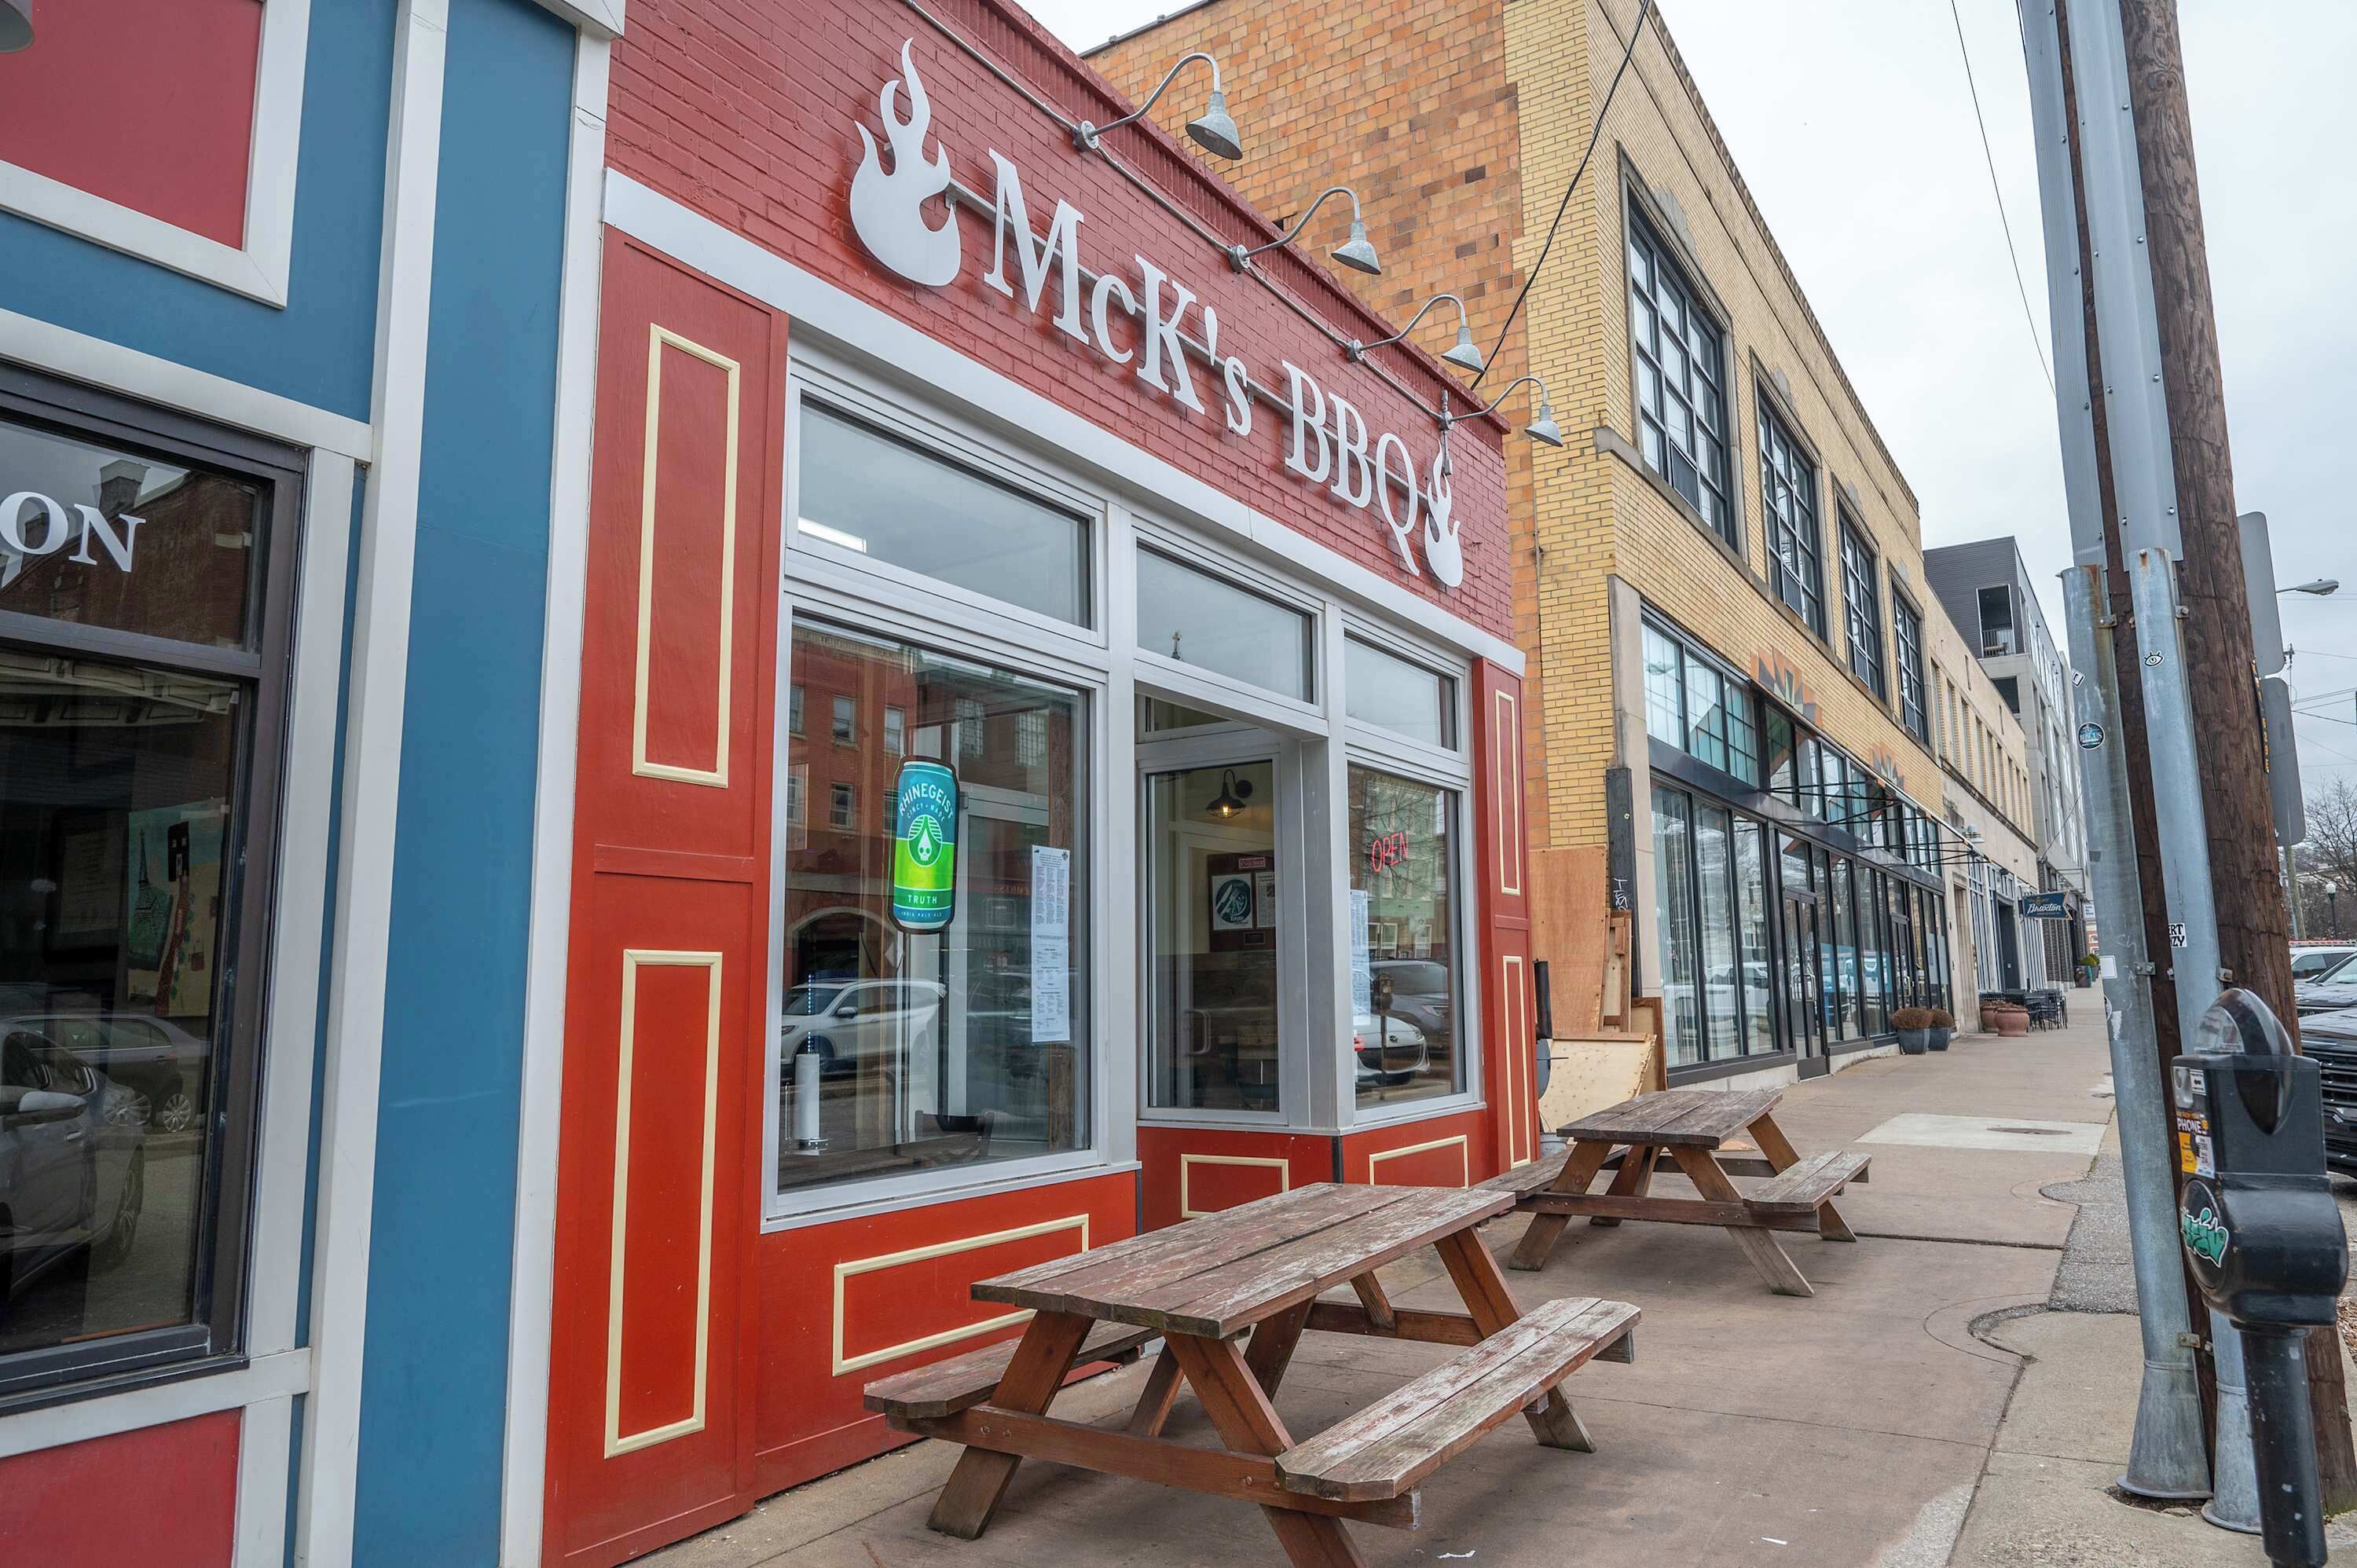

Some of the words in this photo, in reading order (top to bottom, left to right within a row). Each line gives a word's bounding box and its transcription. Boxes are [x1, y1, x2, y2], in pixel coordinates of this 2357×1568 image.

[984, 148, 1252, 438] McK's
[1281, 359, 1420, 577] BBQ
[0, 491, 147, 573] ON
[899, 782, 954, 819] RHINEGEIST
[1371, 830, 1409, 873] OPEN
[907, 894, 937, 904] TRUTH
[2026, 903, 2062, 914] Braxton
